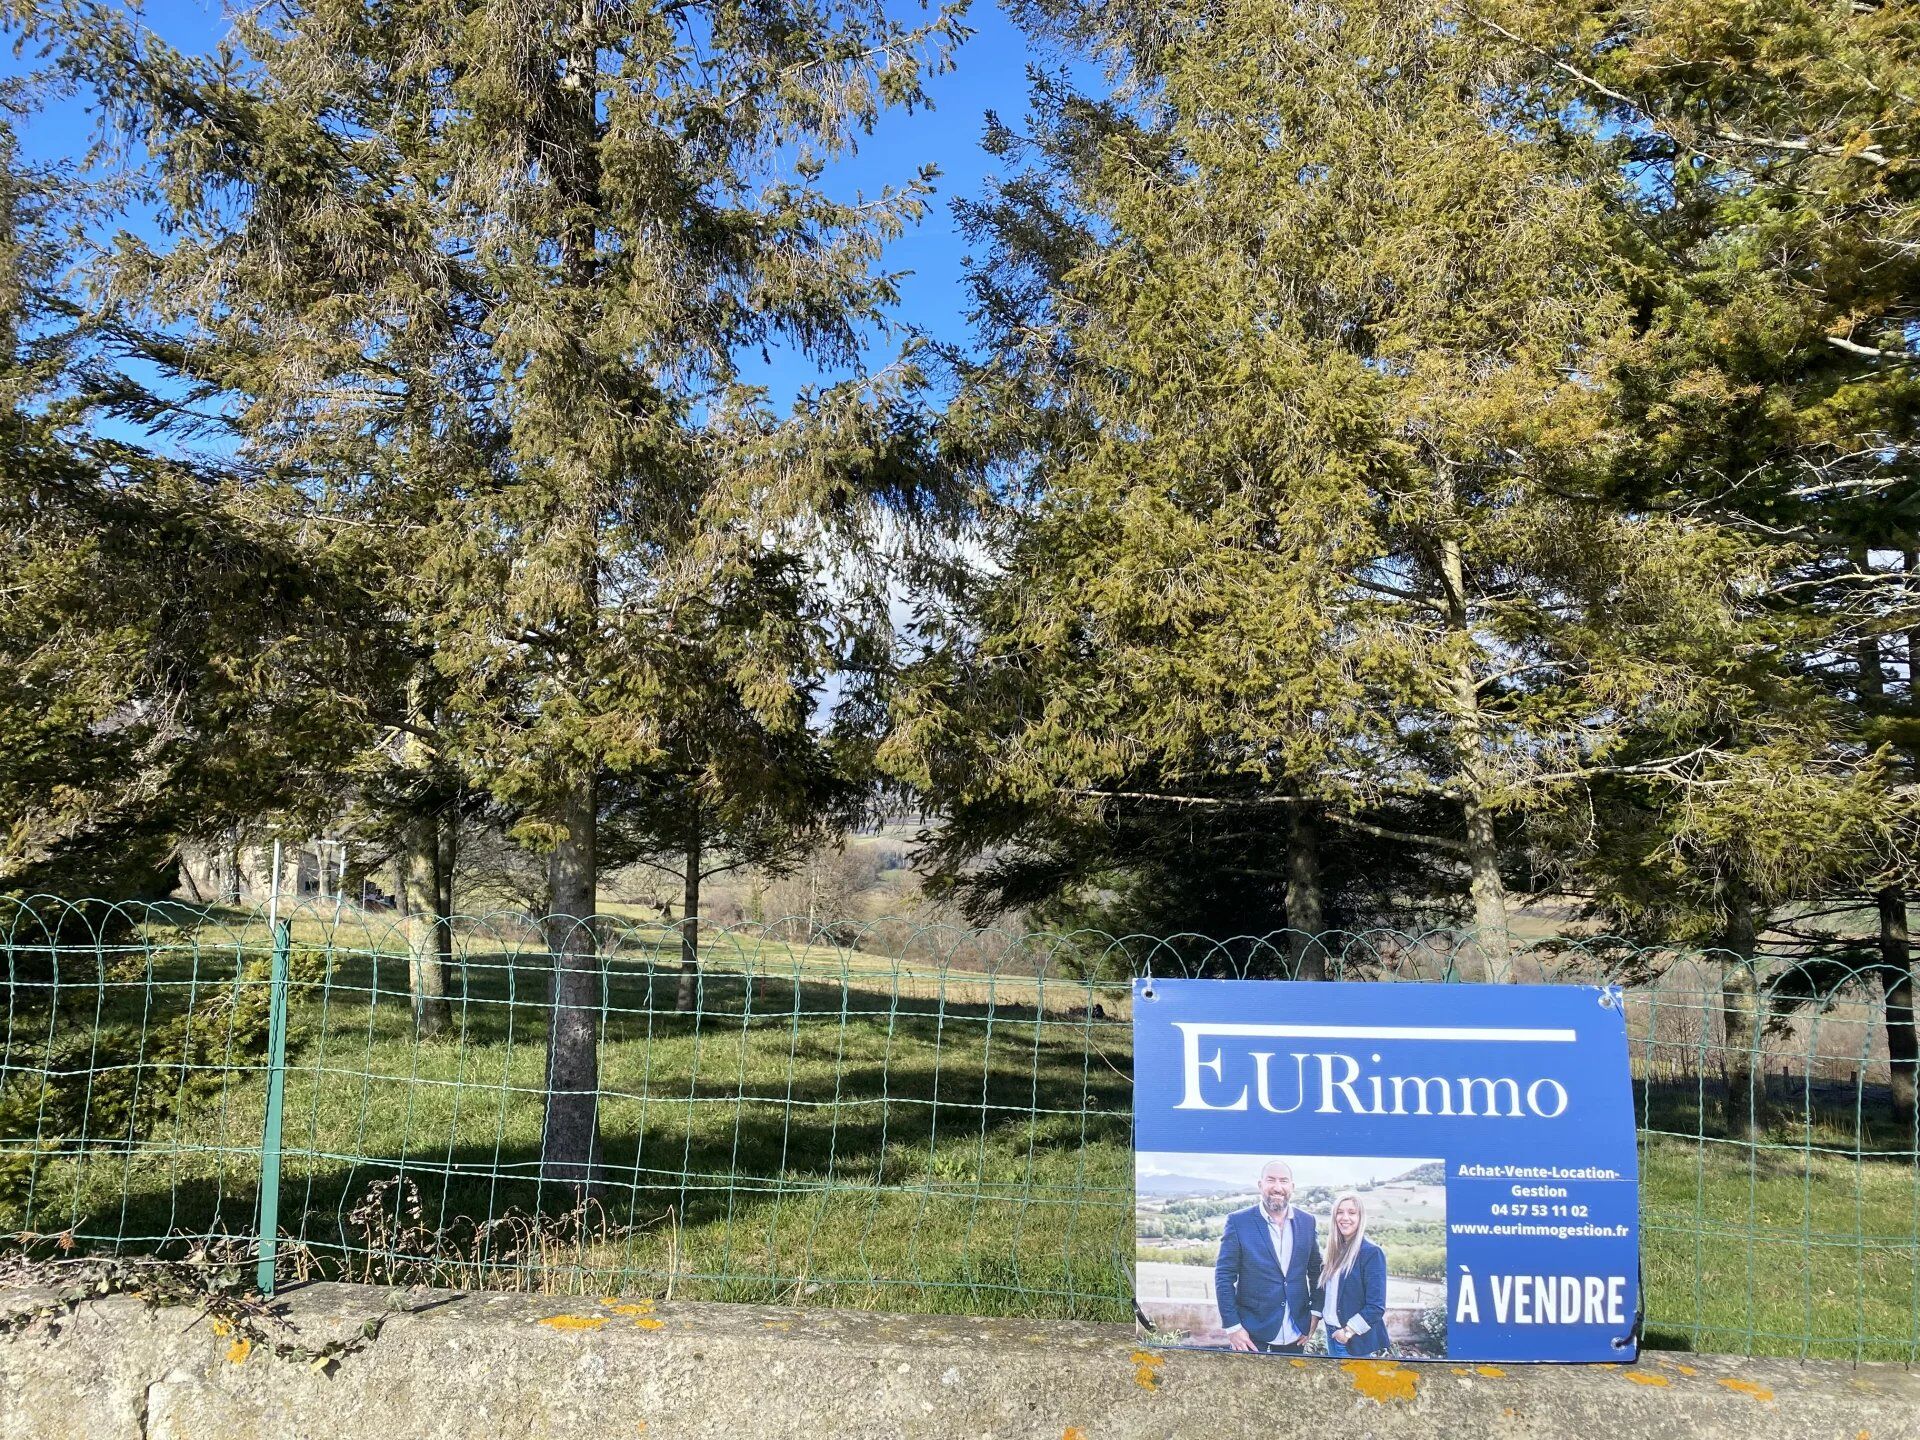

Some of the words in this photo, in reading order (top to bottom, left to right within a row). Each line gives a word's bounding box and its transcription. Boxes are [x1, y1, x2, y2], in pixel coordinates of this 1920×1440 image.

[1171, 1022, 1576, 1118] EURimmo
[1458, 1164, 1620, 1179] Achat-Vente-Location-
[1511, 1185, 1568, 1198] Gestion
[1491, 1204, 1508, 1216] 04
[1511, 1204, 1526, 1217] 57
[1531, 1204, 1548, 1217] 53
[1551, 1205, 1569, 1217] 11
[1571, 1205, 1588, 1218] 02
[1451, 1223, 1629, 1239] www.eurimmogestion.fr
[1455, 1264, 1480, 1323] À
[1490, 1275, 1626, 1324] VENDRE
